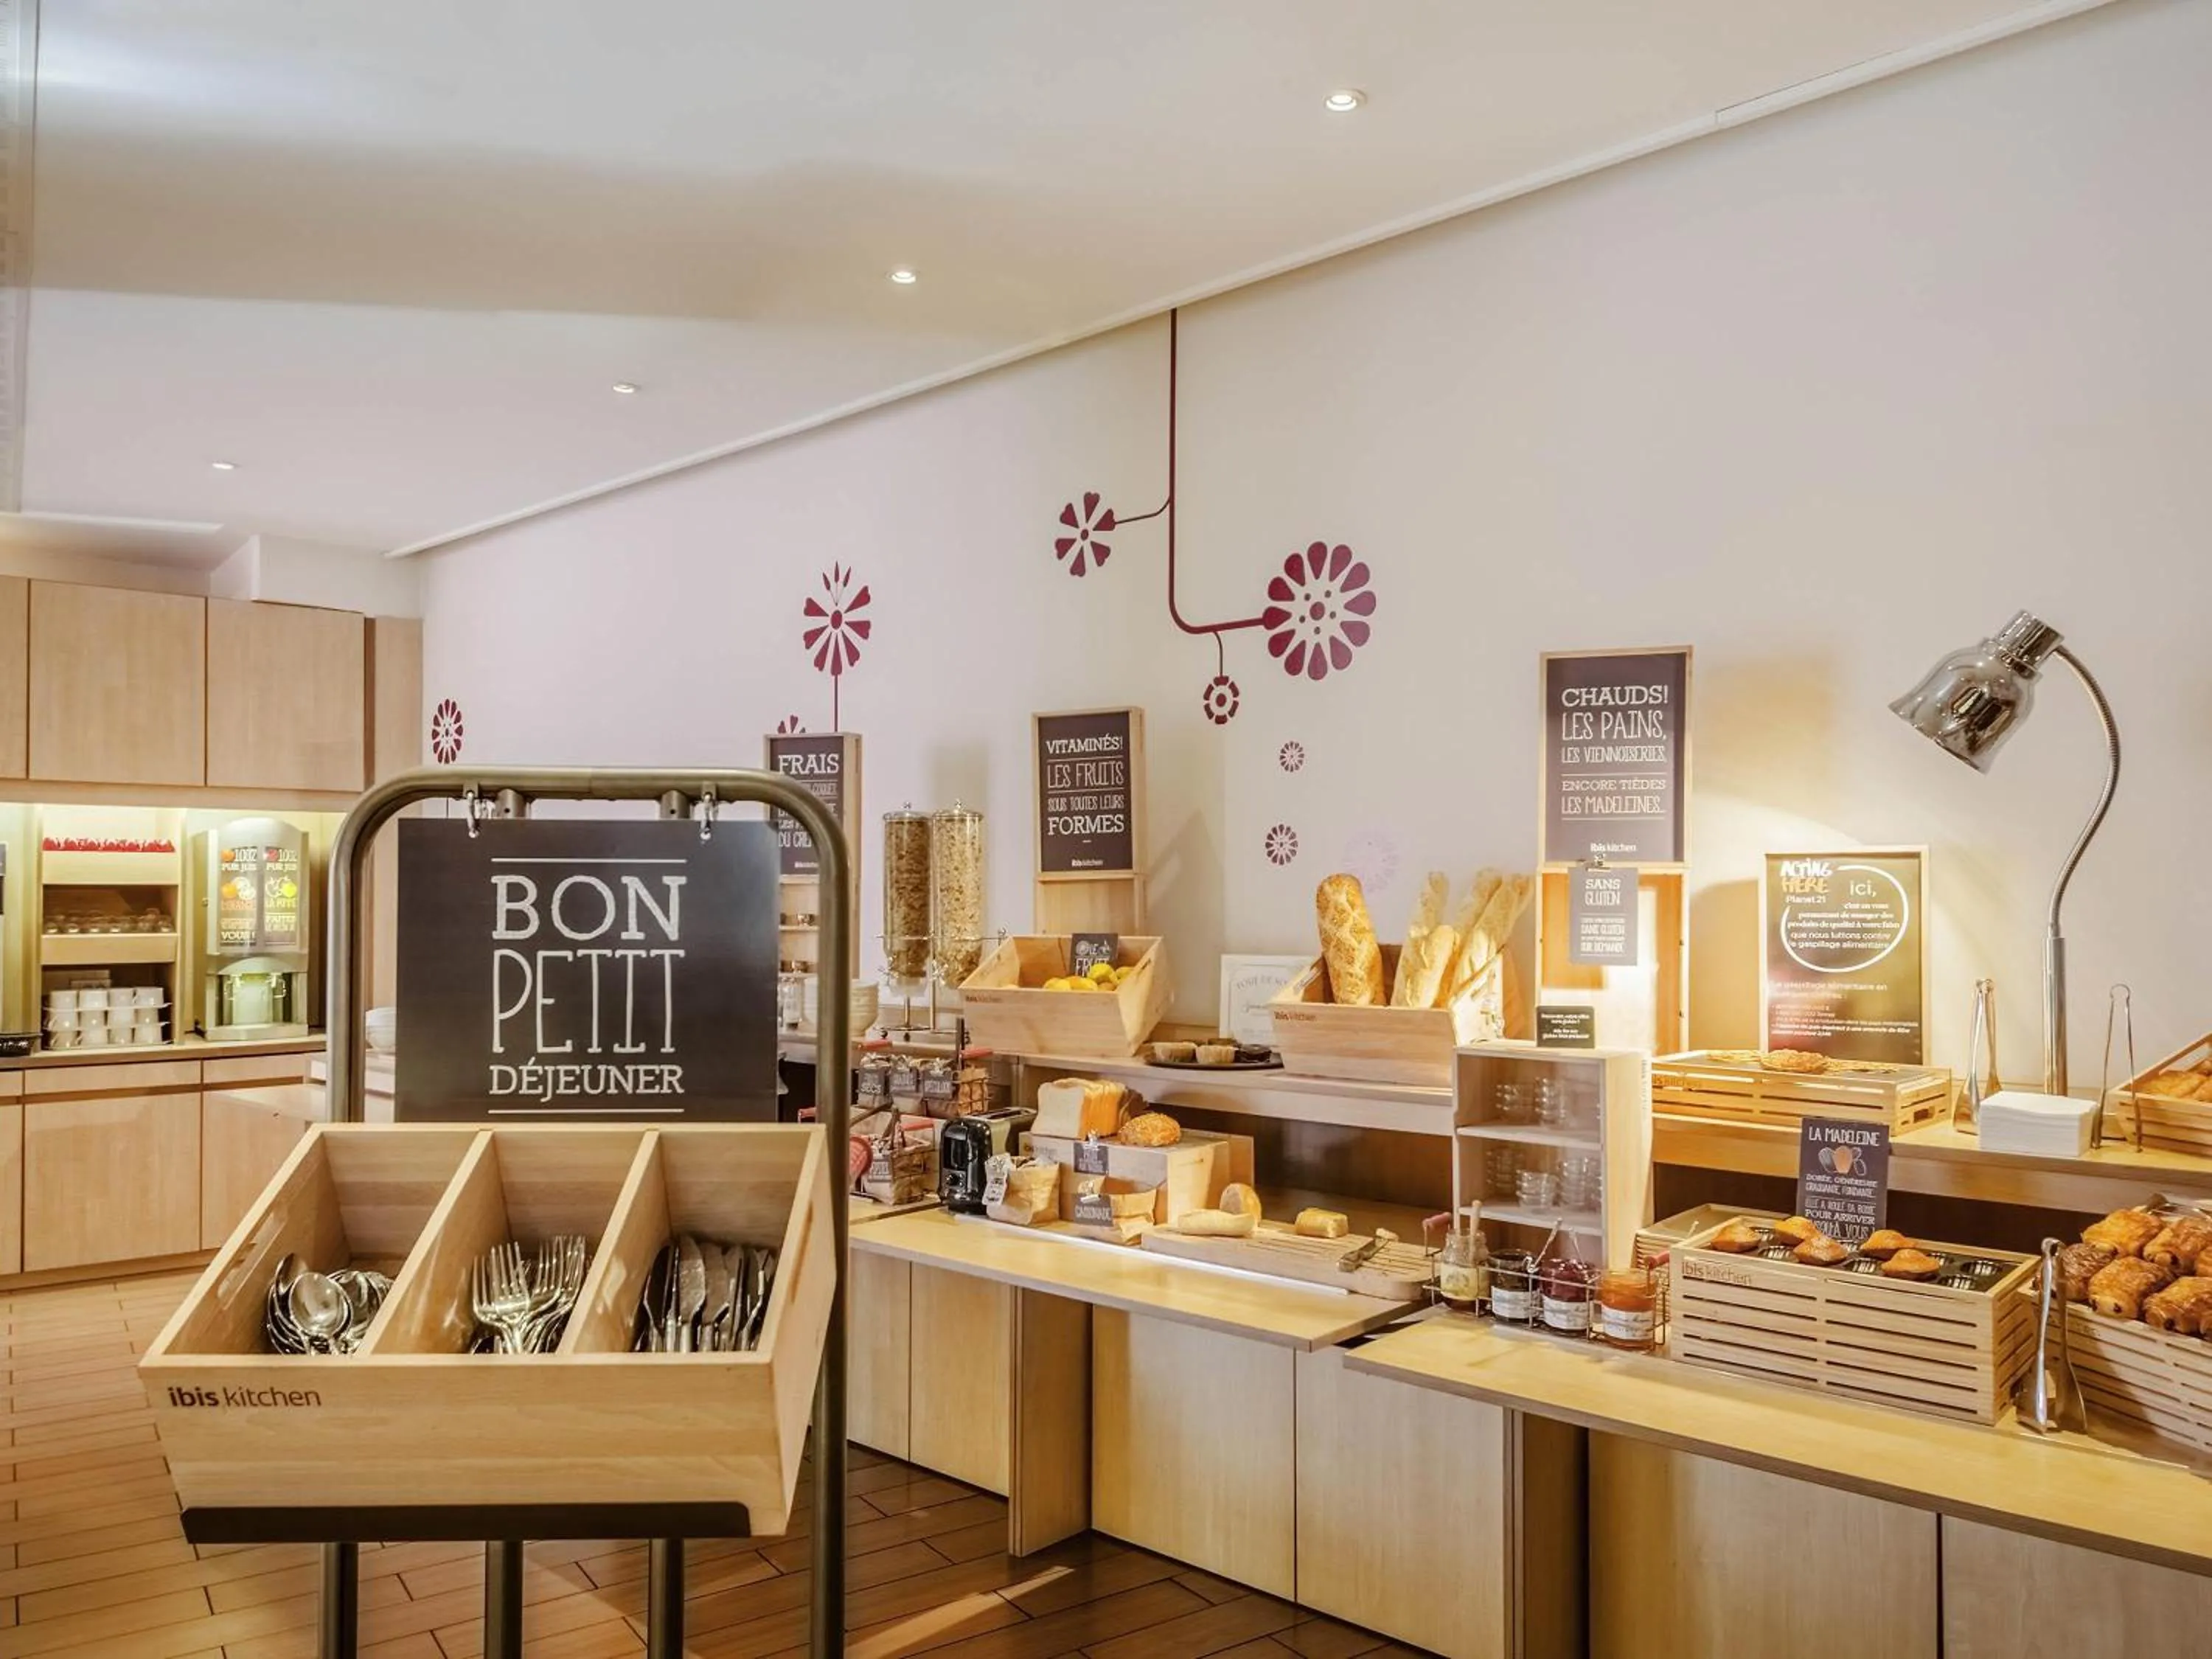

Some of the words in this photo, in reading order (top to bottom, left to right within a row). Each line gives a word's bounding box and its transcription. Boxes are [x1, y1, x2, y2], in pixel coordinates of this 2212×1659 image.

[1561, 684, 1669, 707] CHAUDS!
[1562, 712, 1593, 740] LES
[1601, 710, 1667, 741] PAINS,
[1045, 732, 1124, 754] VITAMINÉS!
[778, 753, 840, 775] FRAIS
[1561, 747, 1580, 763] LES
[1047, 765, 1071, 789] LES
[1075, 761, 1124, 787] FRUITS
[1562, 779, 1617, 792] ENCORE
[1047, 796, 1068, 812] SOUS
[1070, 796, 1098, 811] TOUTES
[1099, 794, 1124, 810] LEURS
[1561, 796, 1582, 815] LES
[1047, 814, 1124, 835] FORMES
[1585, 878, 1621, 890] SANS
[1781, 877, 1829, 894] HERE
[490, 874, 688, 942] BON
[492, 948, 686, 1054] PETIT
[489, 1057, 685, 1102] DÉJEUNER
[1809, 1126, 1822, 1141] LA
[1825, 1127, 1880, 1147] MADELEINE
[1804, 1208, 1832, 1220] POUR
[1833, 1213, 1875, 1225] ARRIVER
[167, 1387, 220, 1408] ibis
[223, 1386, 321, 1408] kitchen
